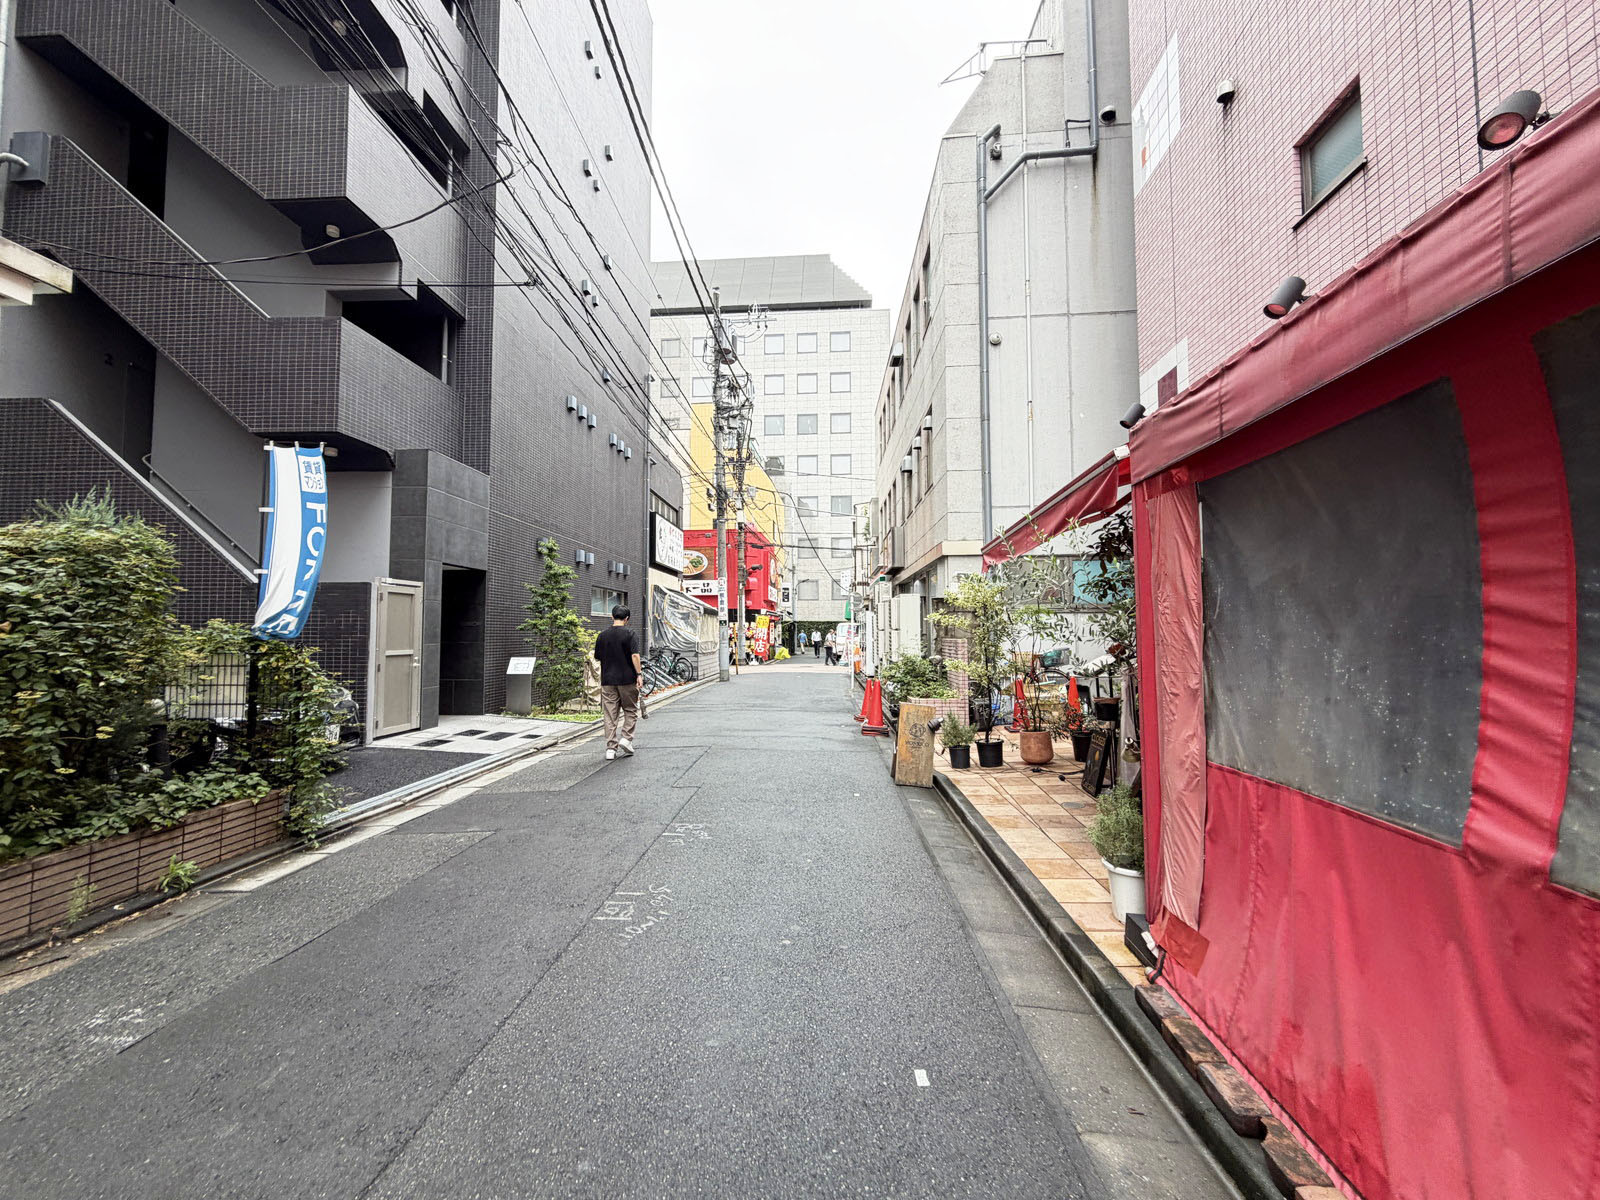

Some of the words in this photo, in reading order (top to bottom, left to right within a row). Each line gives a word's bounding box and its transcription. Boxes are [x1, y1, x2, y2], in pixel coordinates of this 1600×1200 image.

[303, 460, 322, 475] 賃貸
[303, 475, 324, 490] マンション
